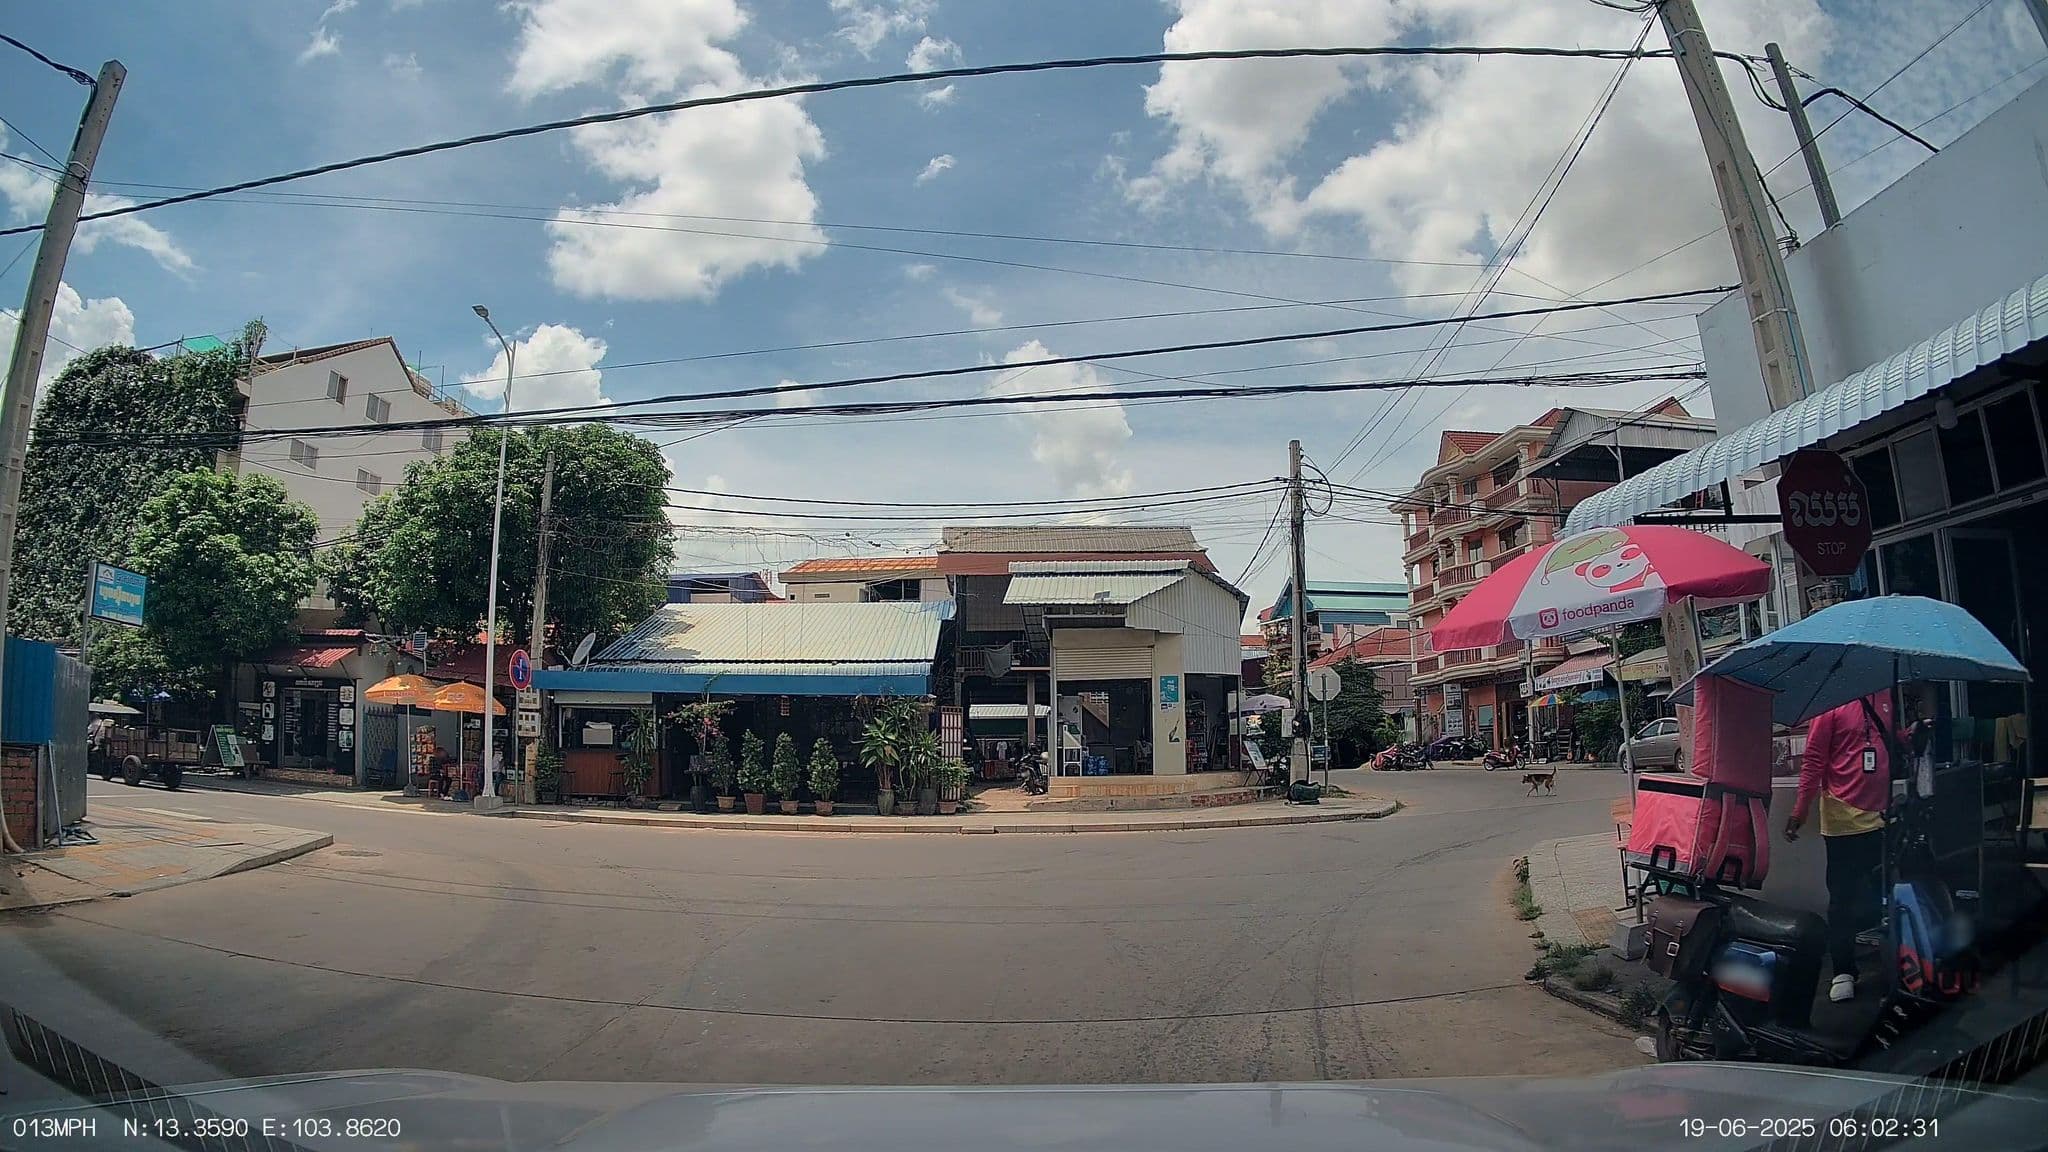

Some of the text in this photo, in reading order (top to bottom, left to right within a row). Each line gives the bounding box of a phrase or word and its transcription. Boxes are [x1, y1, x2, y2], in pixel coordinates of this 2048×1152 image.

[1788, 475, 1860, 527] ឈប់
[1818, 542, 1847, 555] STOP
[1562, 596, 1635, 620] foodpanda
